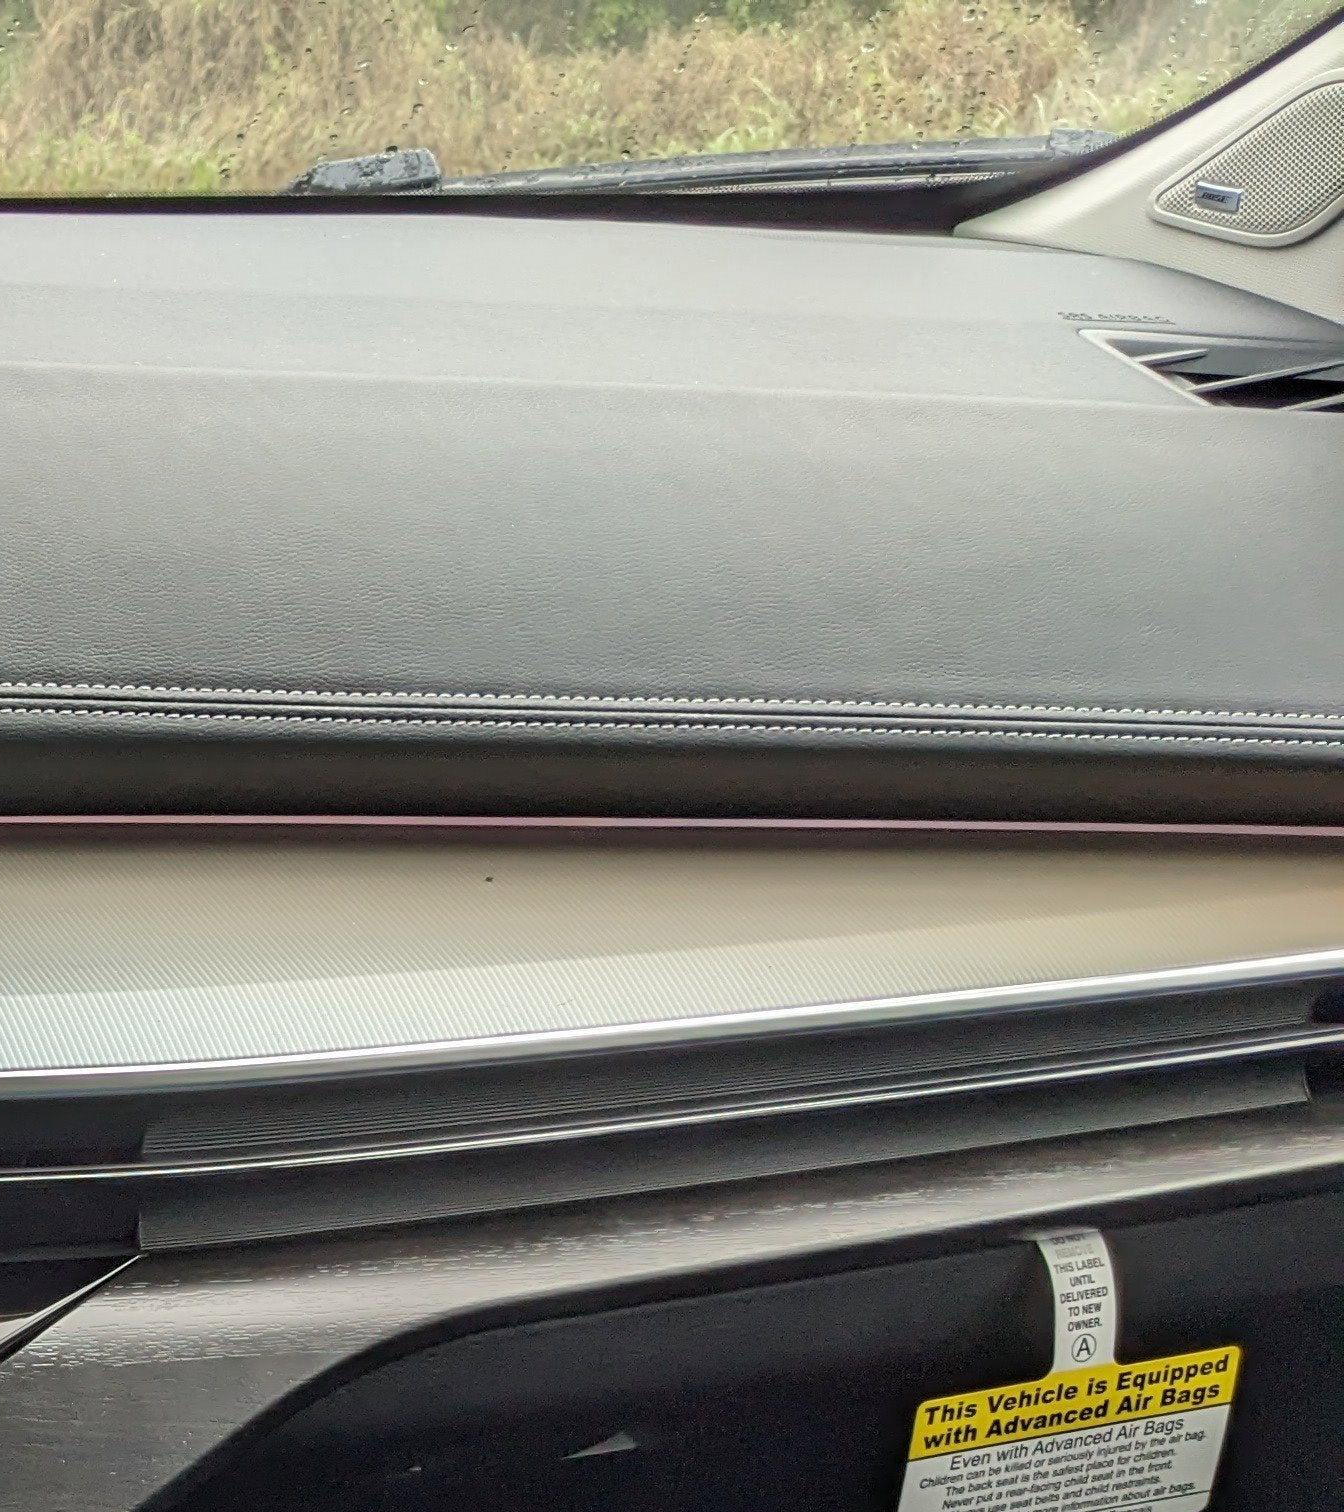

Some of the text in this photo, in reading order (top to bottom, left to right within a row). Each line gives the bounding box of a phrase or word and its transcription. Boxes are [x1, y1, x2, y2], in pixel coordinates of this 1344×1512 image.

[1053, 1257, 1105, 1275] THIS LABEL
[1069, 1274, 1096, 1287] UNTIL
[1060, 1286, 1109, 1304] DELIVERED
[1067, 1302, 1103, 1317] TO NEW
[925, 1353, 1230, 1425] This Vehicle is Equipped
[923, 1383, 1220, 1450] with Advanced Air Bags
[949, 1418, 1185, 1471] Even with Advanced Air Bags
[919, 1472, 963, 1489] Children
[966, 1469, 986, 1481] can
[988, 1465, 1002, 1477] be
[1034, 1458, 1046, 1469] or
[1047, 1447, 1094, 1466] seriously
[1096, 1441, 1133, 1457] injured
[1134, 1439, 1148, 1452] by
[1149, 1436, 1166, 1448] the
[945, 1484, 965, 1497] The
[967, 1479, 993, 1493] back
[1032, 1469, 1050, 1481] the
[941, 1495, 974, 1510] Never
